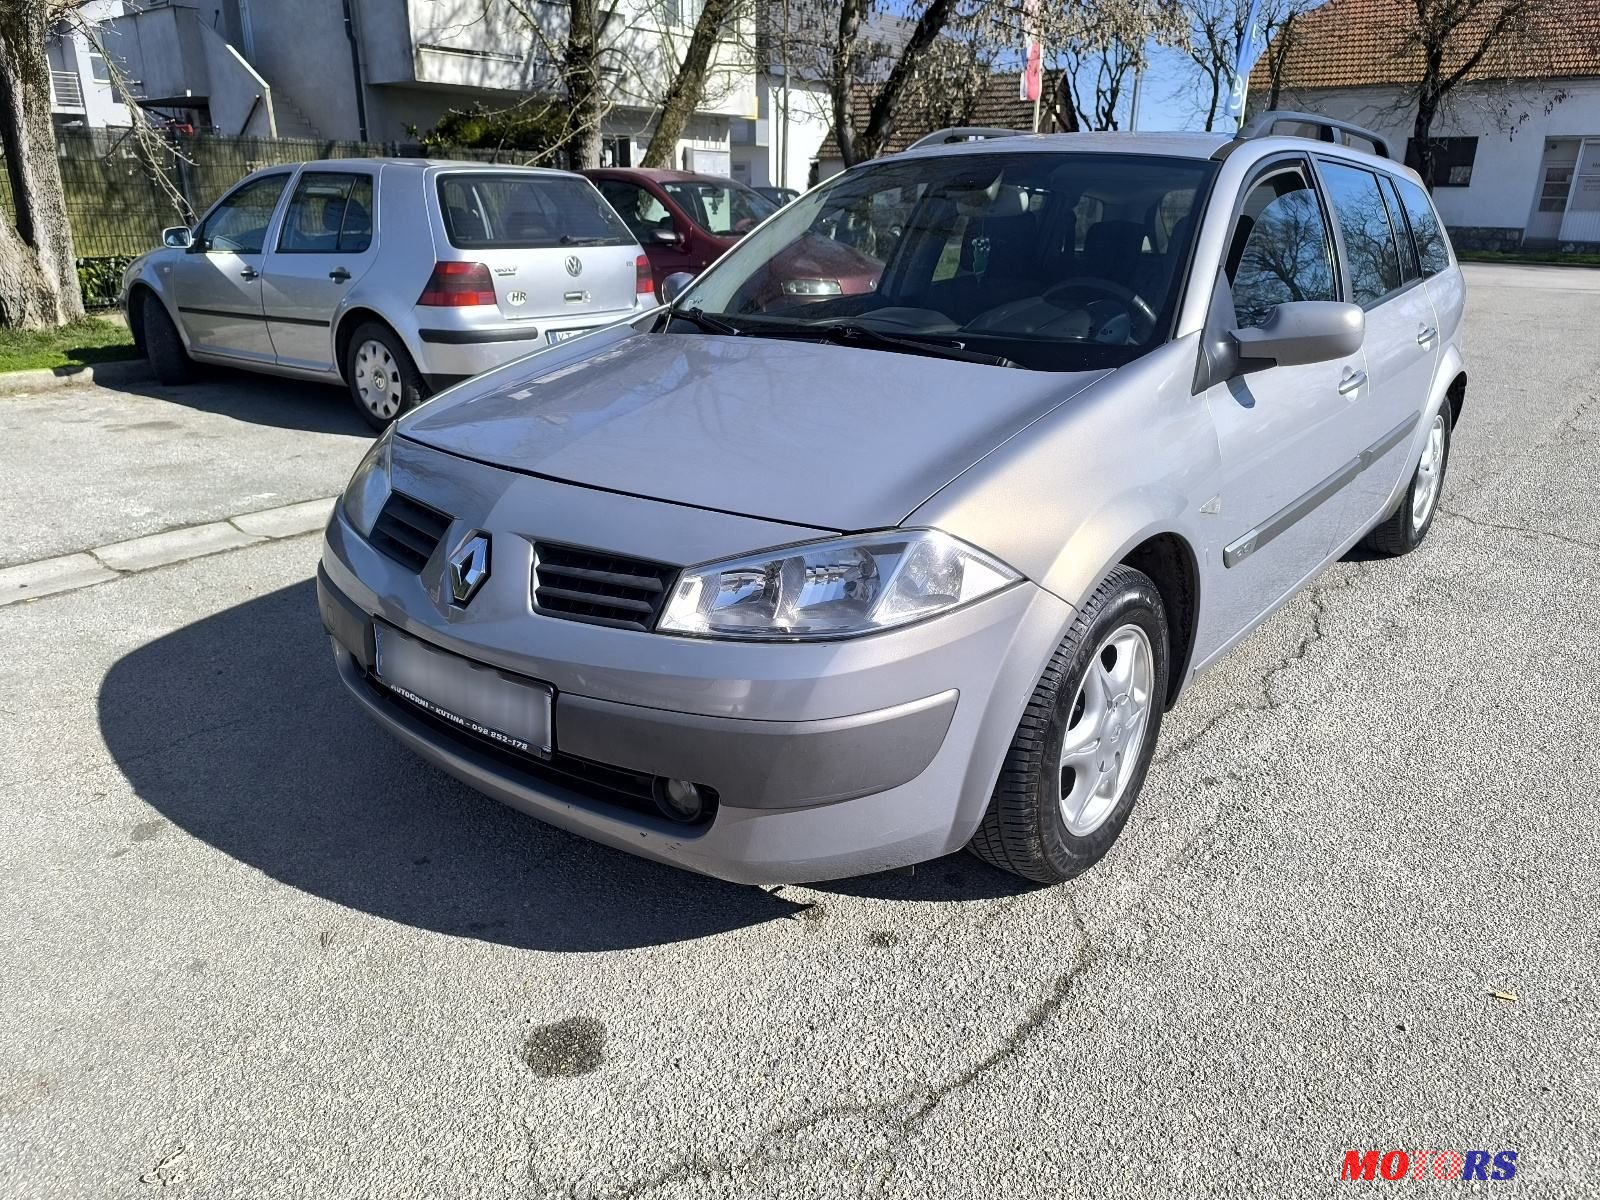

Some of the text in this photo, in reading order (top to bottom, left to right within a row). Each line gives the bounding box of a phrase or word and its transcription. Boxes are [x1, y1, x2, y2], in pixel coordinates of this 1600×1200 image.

[512, 291, 527, 301] HR
[436, 707, 464, 725] KUTINA
[472, 723, 488, 735] 098
